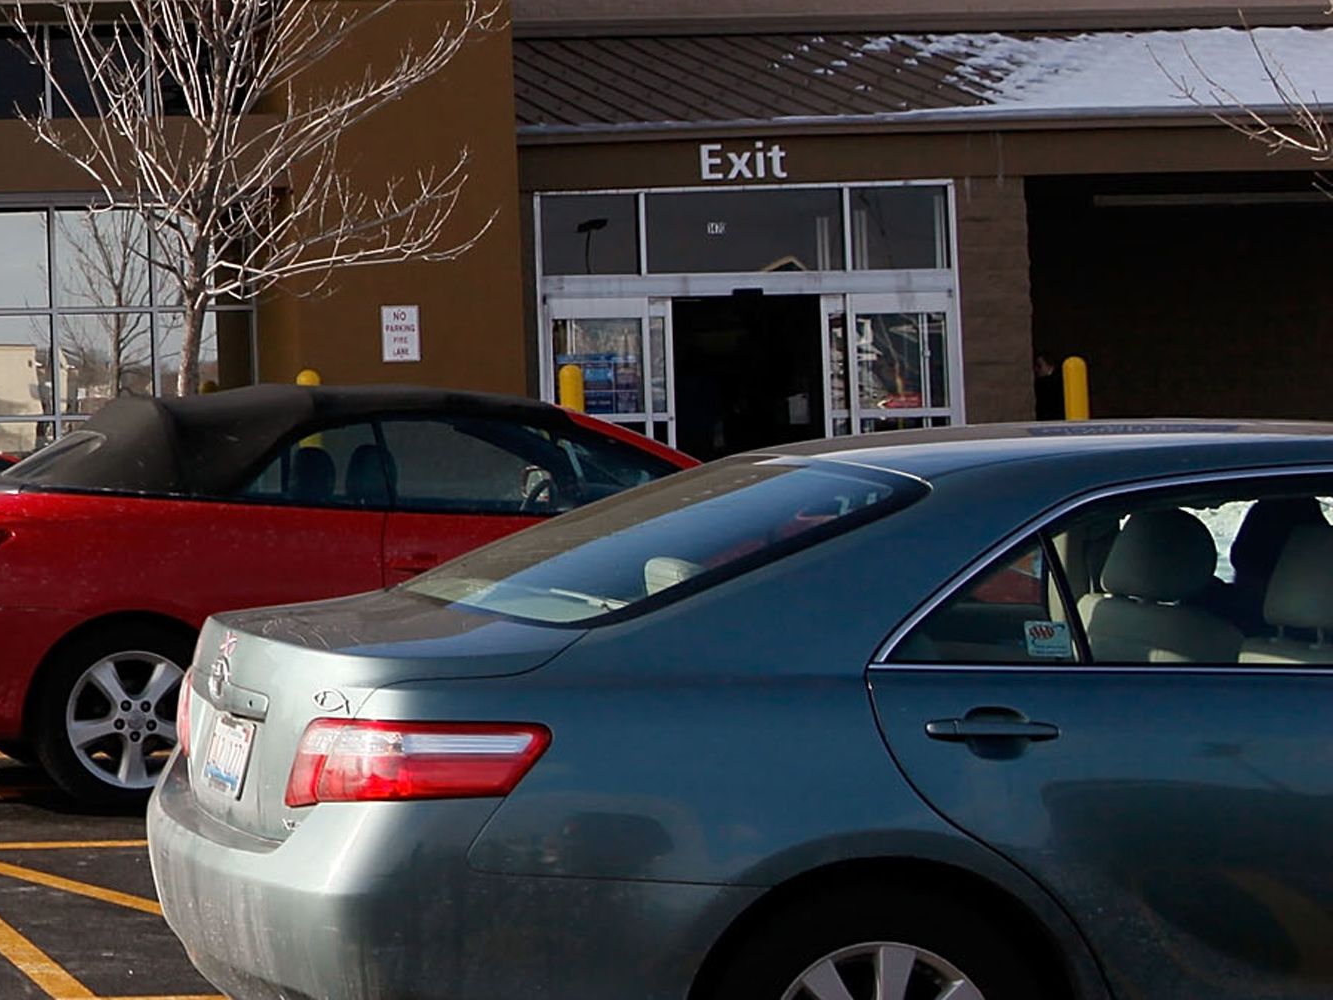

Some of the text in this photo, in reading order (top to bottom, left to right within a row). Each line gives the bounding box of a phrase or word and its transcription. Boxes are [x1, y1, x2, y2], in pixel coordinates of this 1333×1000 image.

[700, 141, 788, 181] Exit
[393, 311, 407, 321] NO
[385, 324, 415, 333] PARKING
